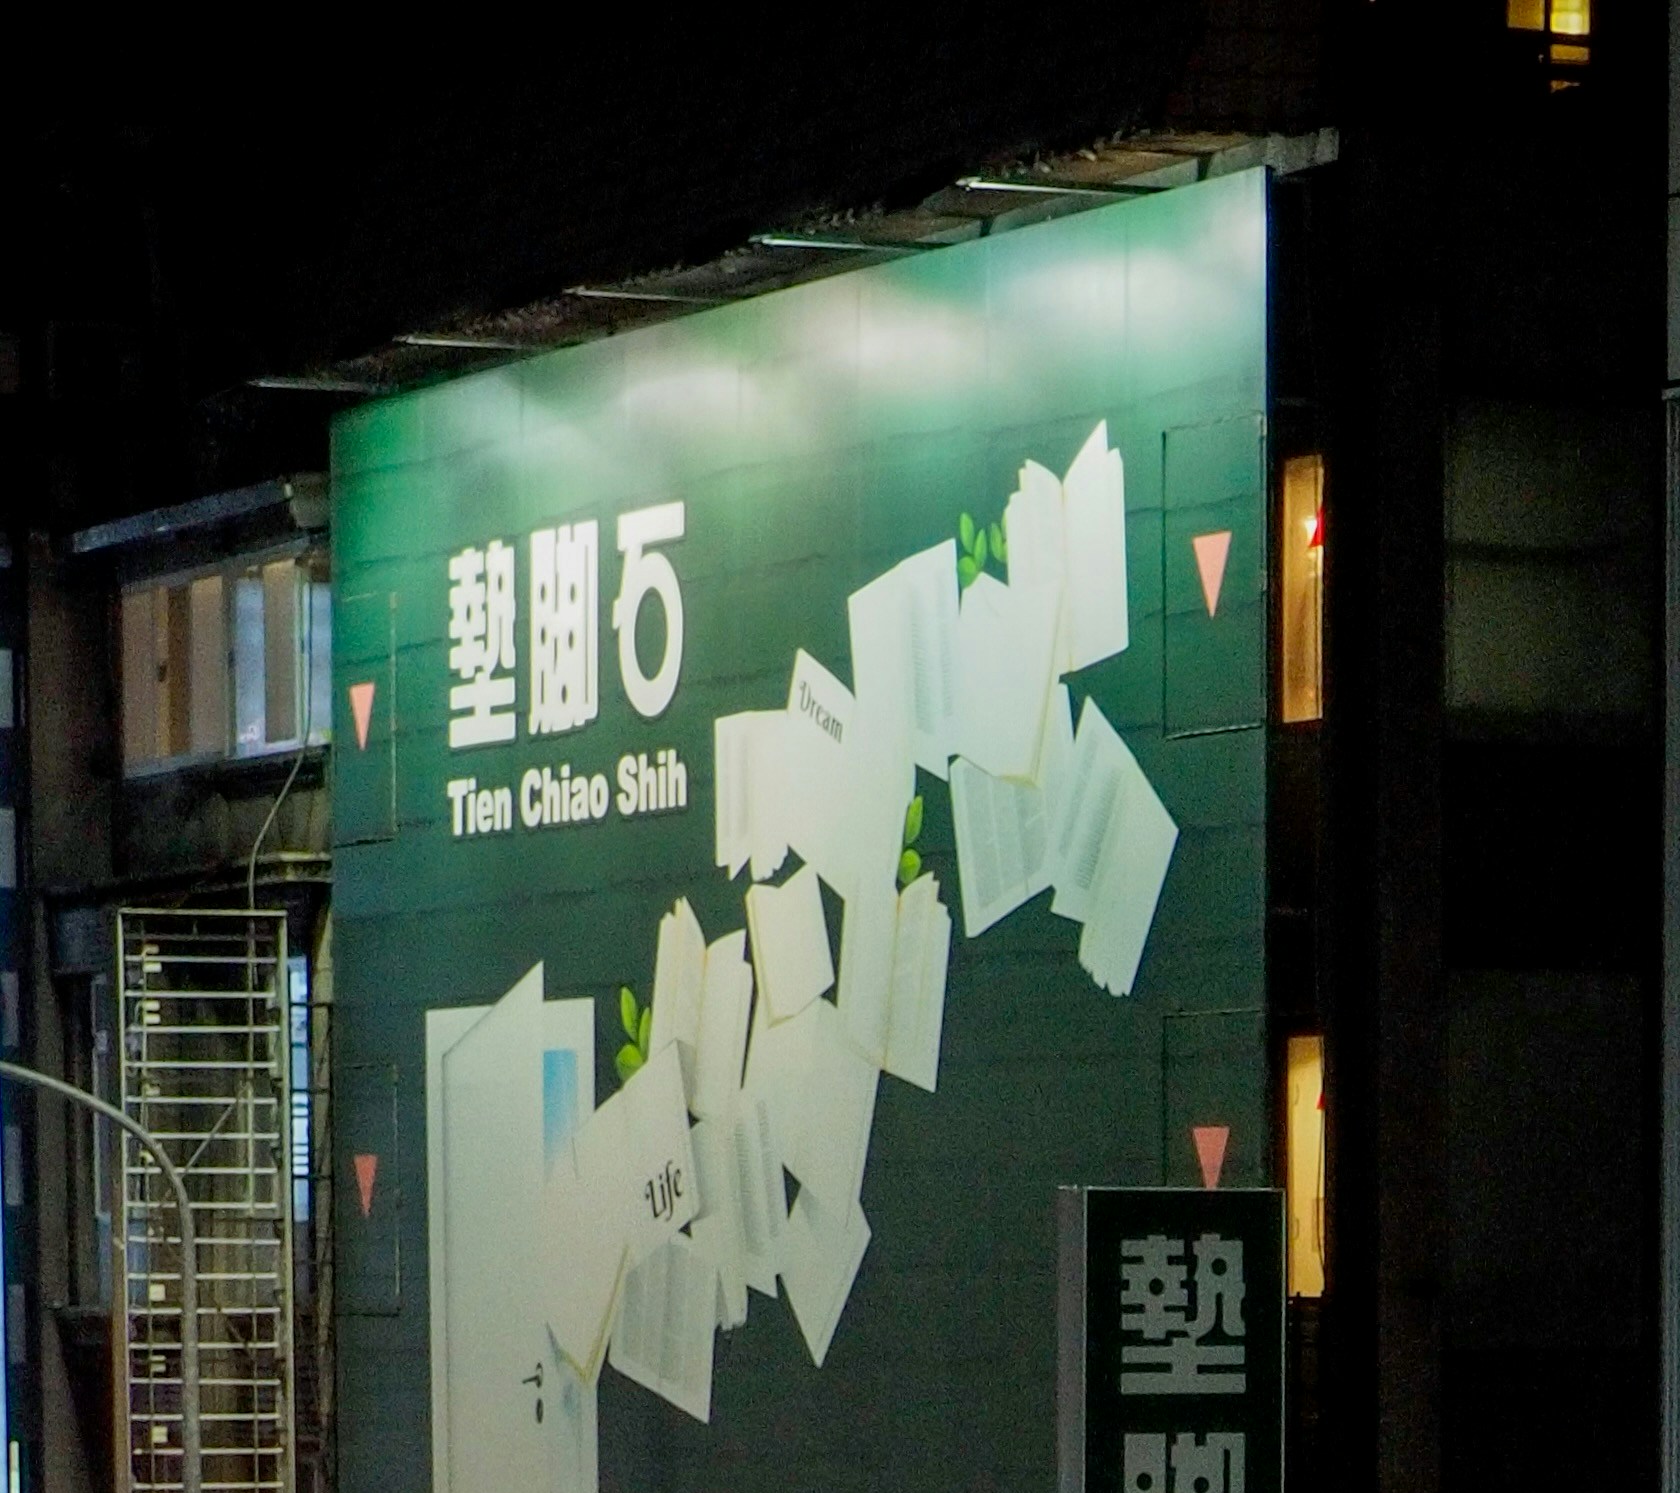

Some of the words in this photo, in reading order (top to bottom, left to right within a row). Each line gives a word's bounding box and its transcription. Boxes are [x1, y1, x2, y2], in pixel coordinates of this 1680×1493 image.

[799, 679, 844, 744] Dream
[448, 777, 512, 836] Tien
[520, 768, 607, 827] Chiao
[617, 749, 687, 816] Shih
[645, 1159, 683, 1221] Life
